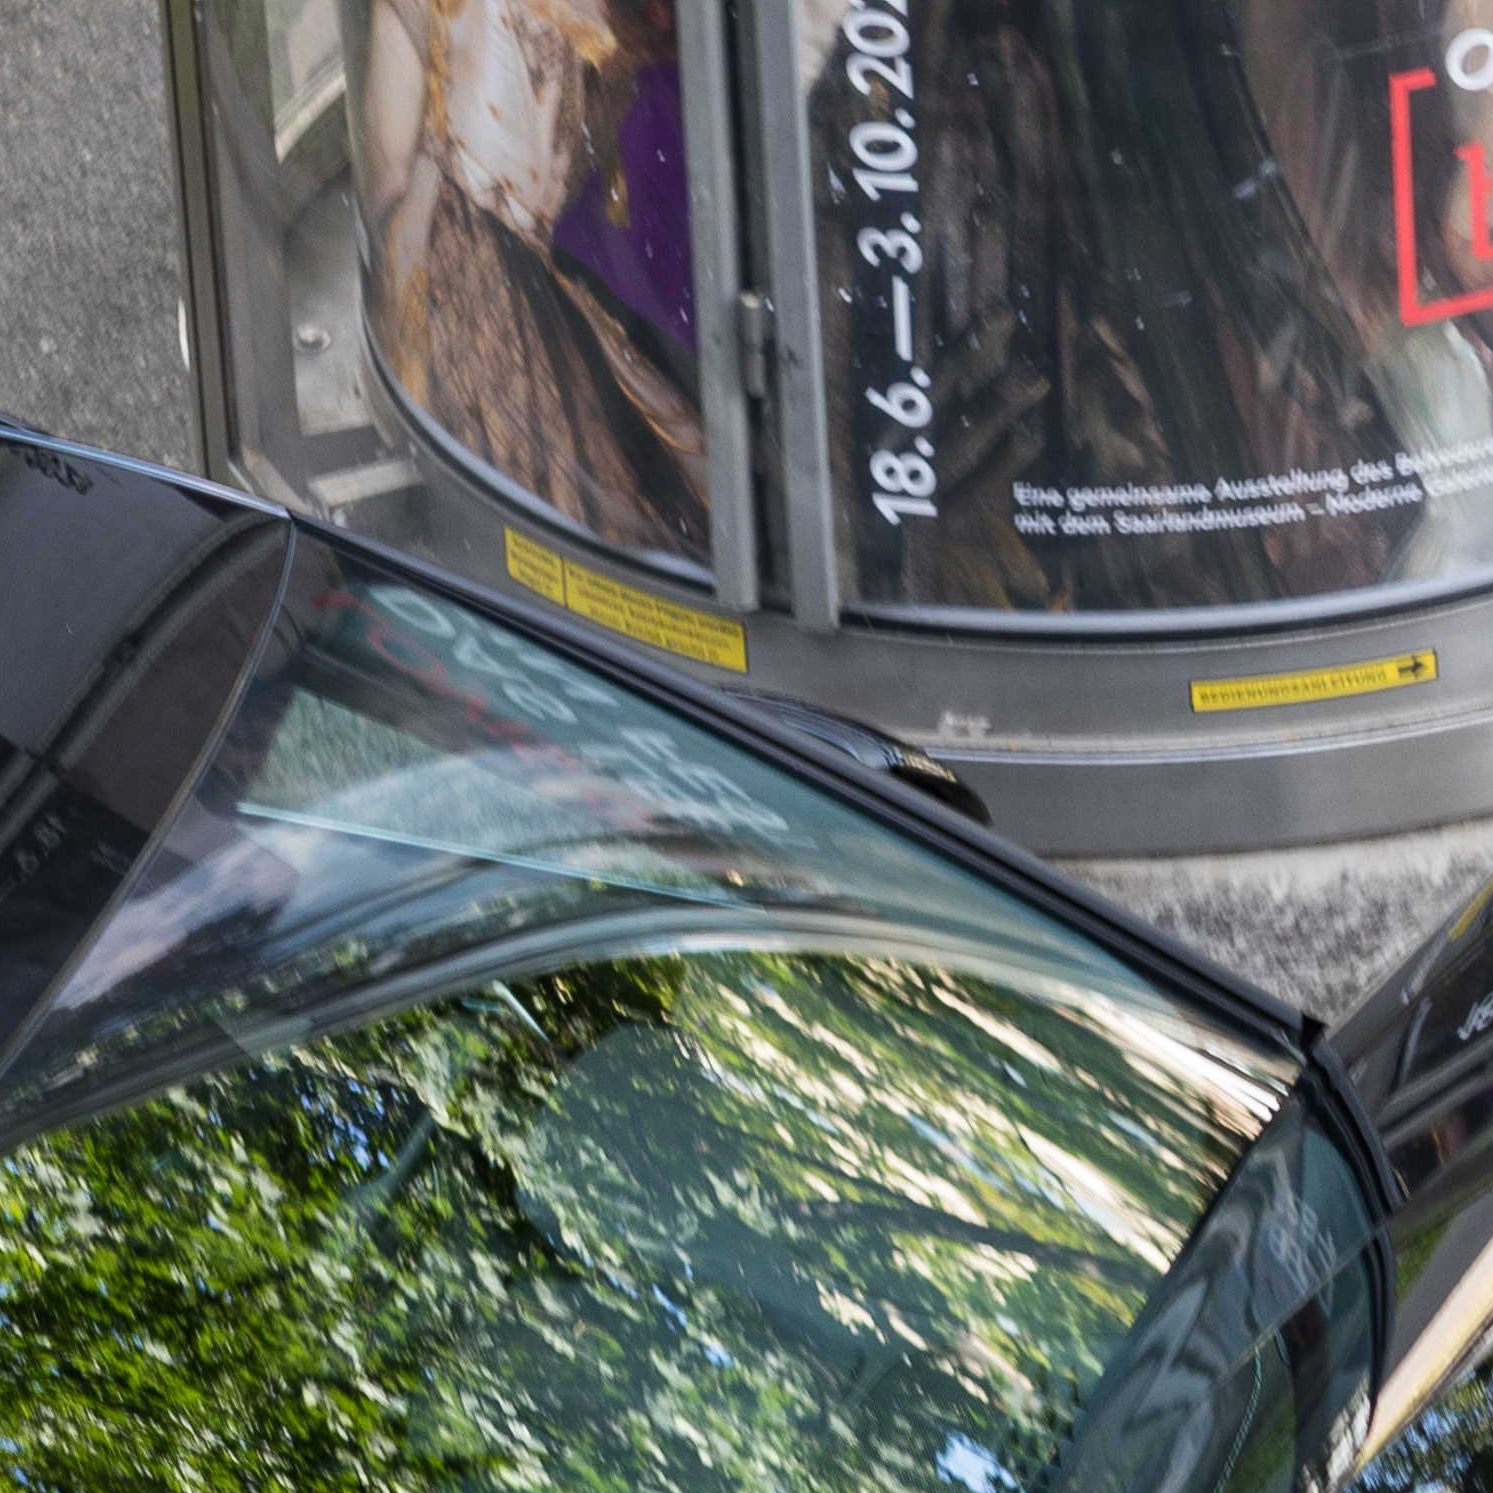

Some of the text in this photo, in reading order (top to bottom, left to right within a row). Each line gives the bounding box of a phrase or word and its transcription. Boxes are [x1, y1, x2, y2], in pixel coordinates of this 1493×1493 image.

[1066, 478, 1213, 512] gemeinsame
[1213, 466, 1350, 502] Ausstellung
[1350, 457, 1394, 486] des
[1112, 500, 1307, 536] Saarlandmuseum
[1325, 482, 1425, 518] Moderne
